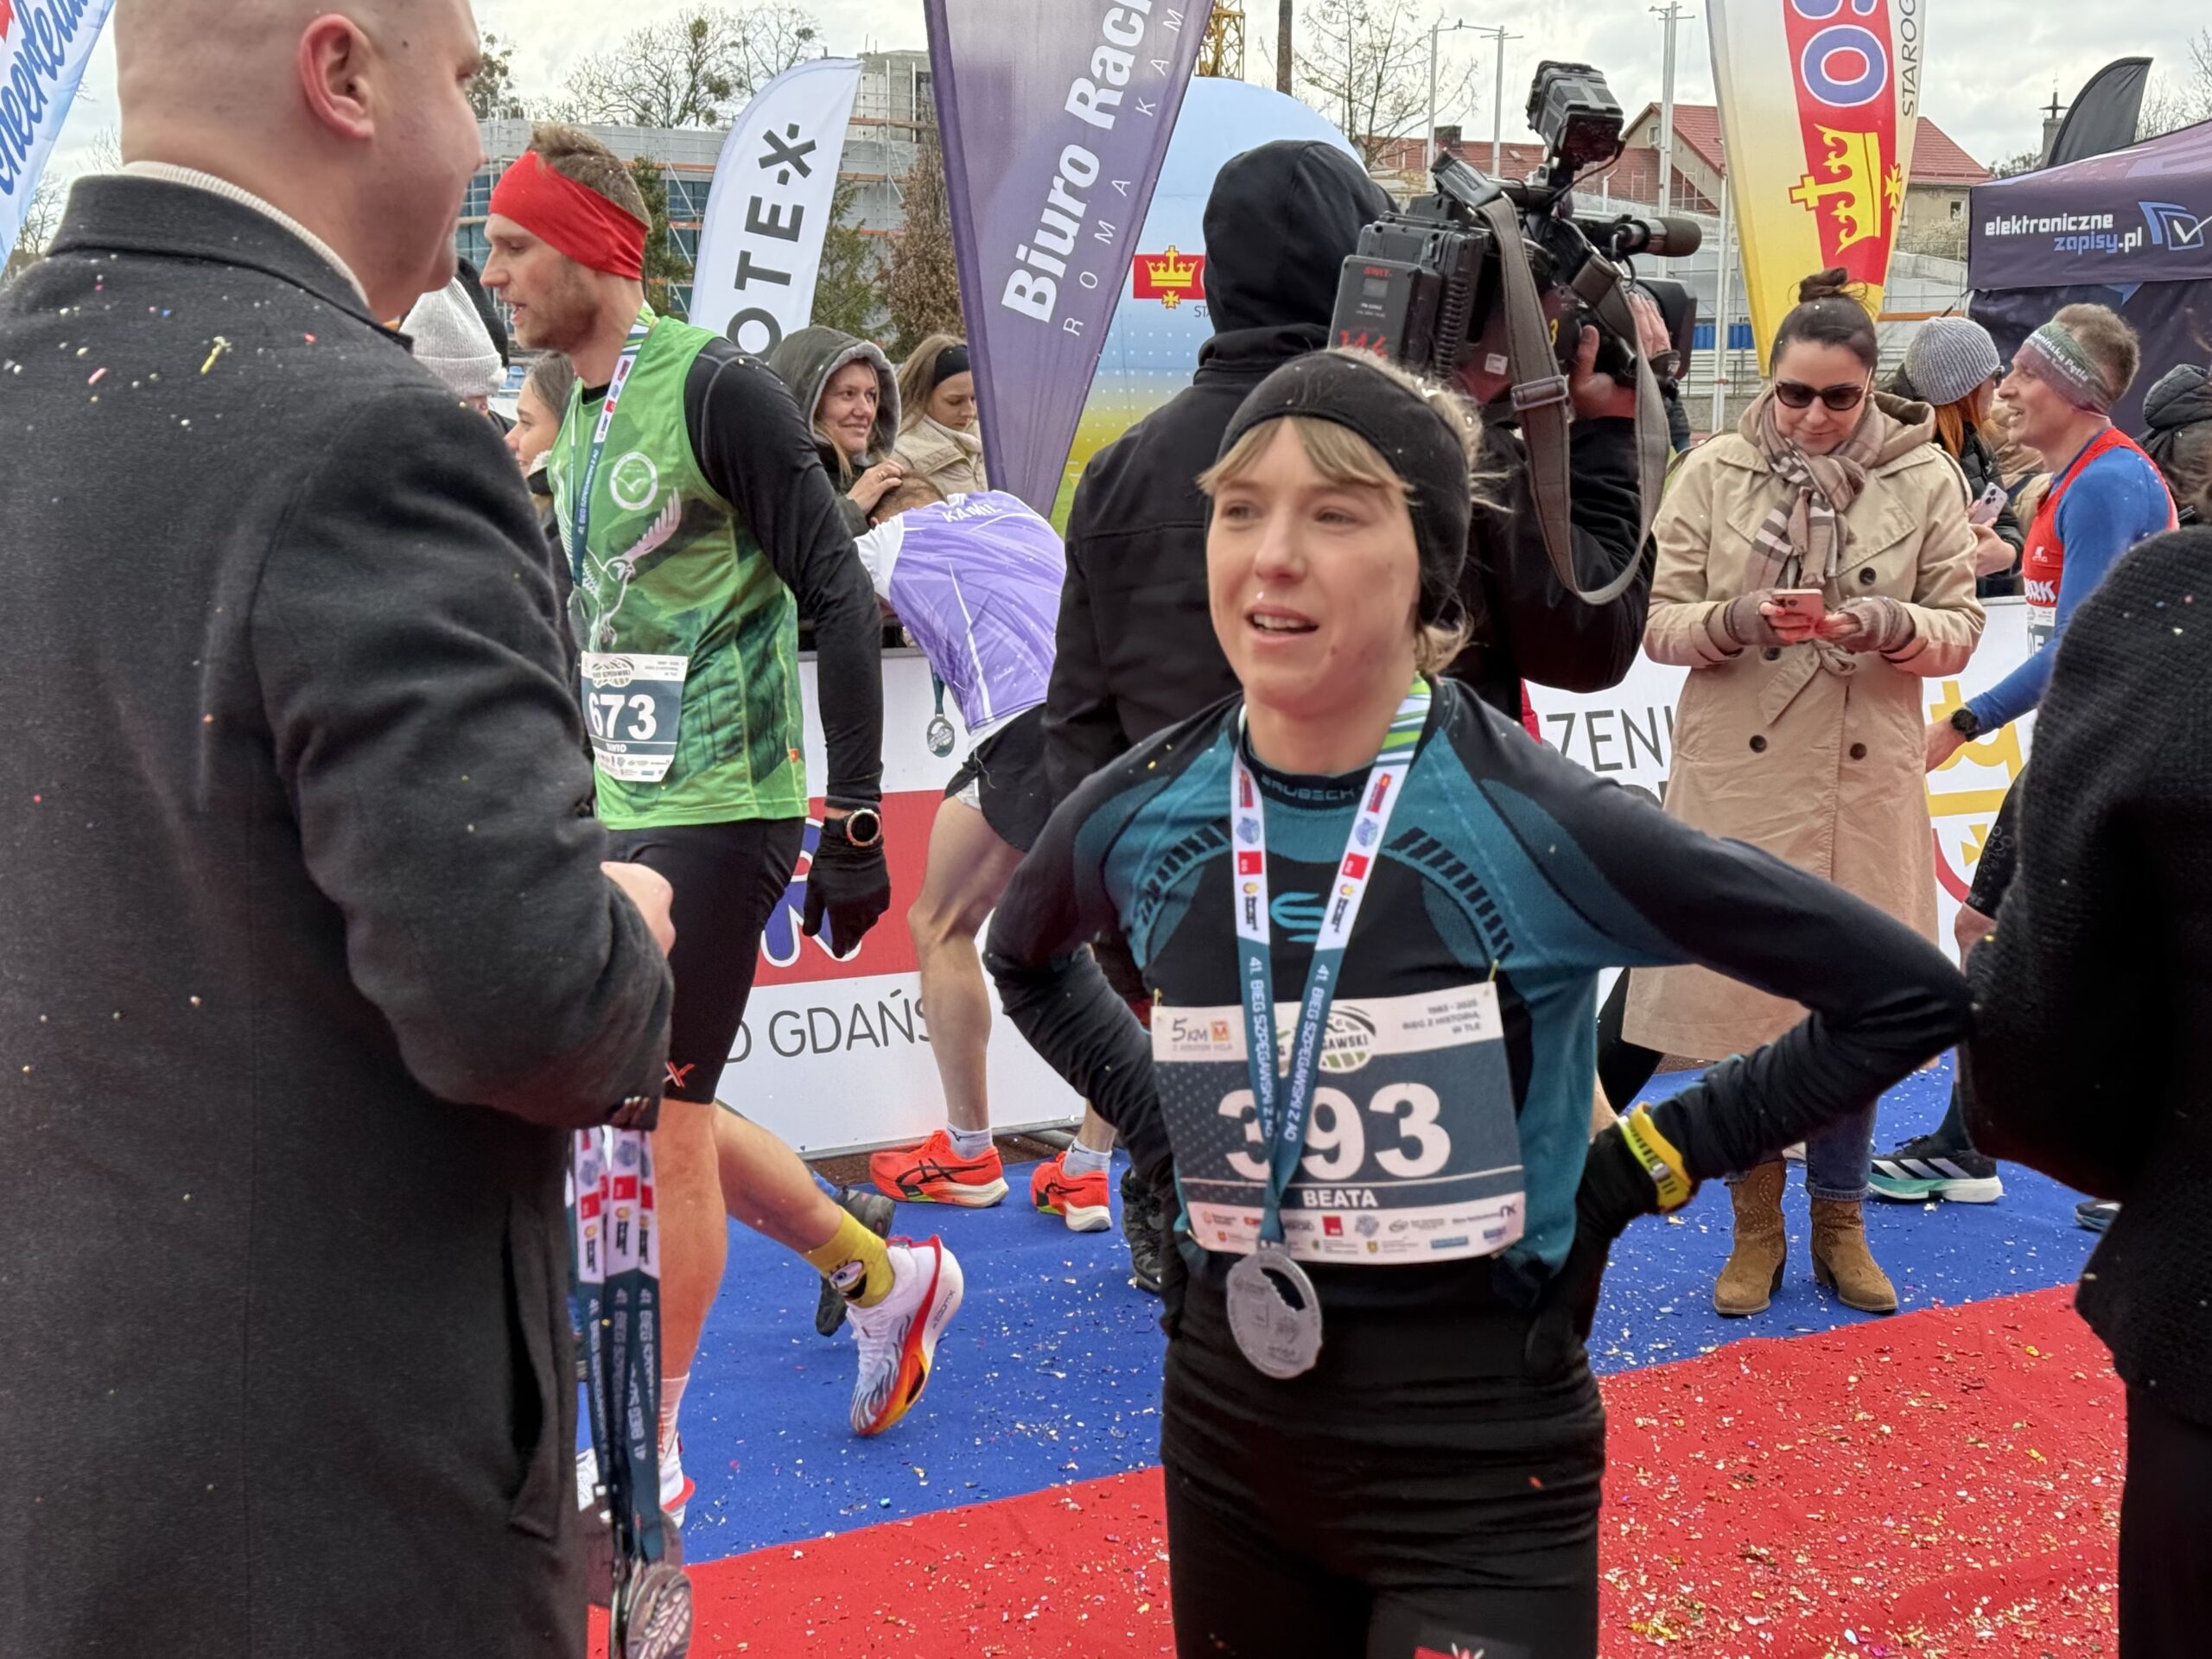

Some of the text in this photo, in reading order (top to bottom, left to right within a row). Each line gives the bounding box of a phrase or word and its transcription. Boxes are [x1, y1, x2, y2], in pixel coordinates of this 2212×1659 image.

[1001, 144, 1100, 323] Biuro
[1985, 213, 2113, 236] elektroniczne
[2054, 226, 2142, 255] zapisy.pl
[942, 503, 1002, 524] KAMIL
[588, 692, 657, 740] 673
[1250, 979, 1266, 1012] BIEG
[1306, 986, 1325, 1020] BIEG
[1218, 1083, 1451, 1180] 393
[1302, 1190, 1379, 1208] BEATA
